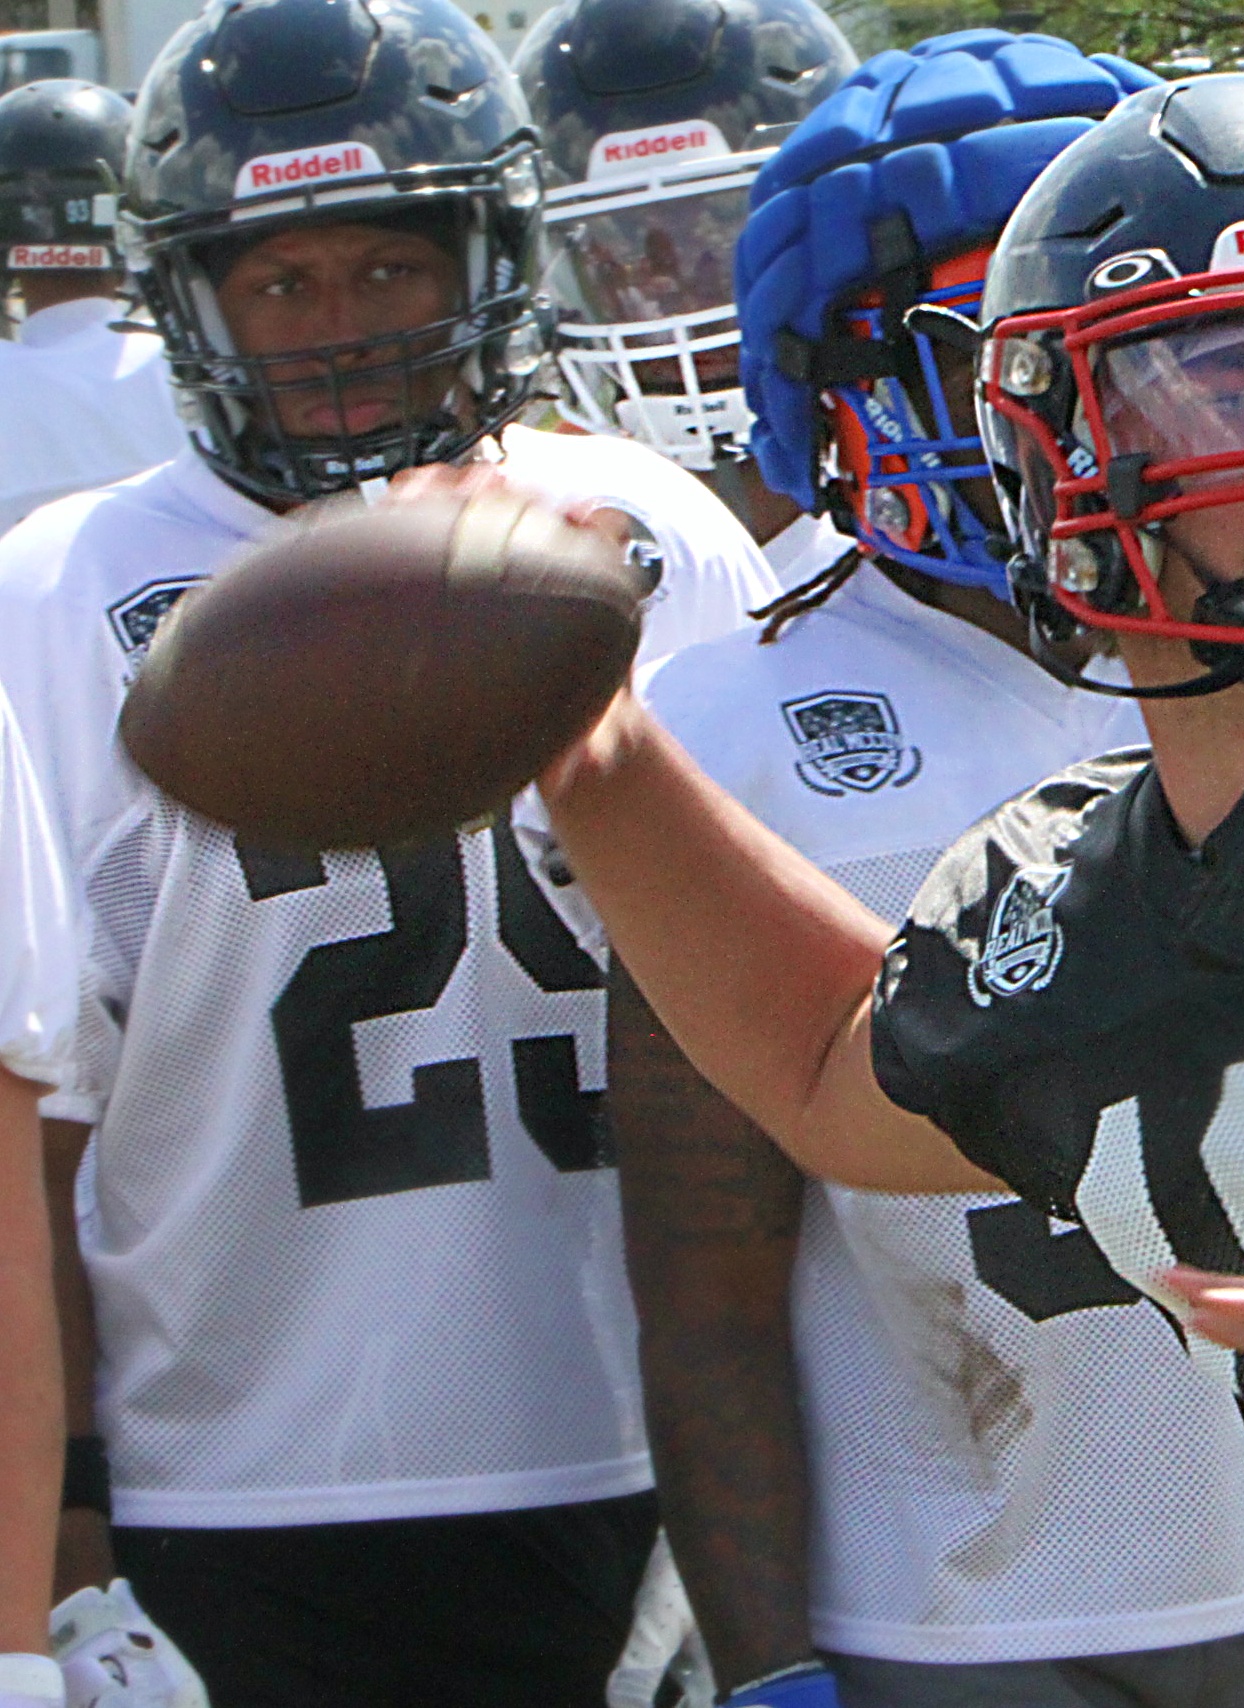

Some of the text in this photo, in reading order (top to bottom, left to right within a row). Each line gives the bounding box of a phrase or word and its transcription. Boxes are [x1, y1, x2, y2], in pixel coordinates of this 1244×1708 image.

[604, 130, 706, 162] Riddell
[251, 148, 362, 187] Riddell
[14, 247, 103, 266] Riddell
